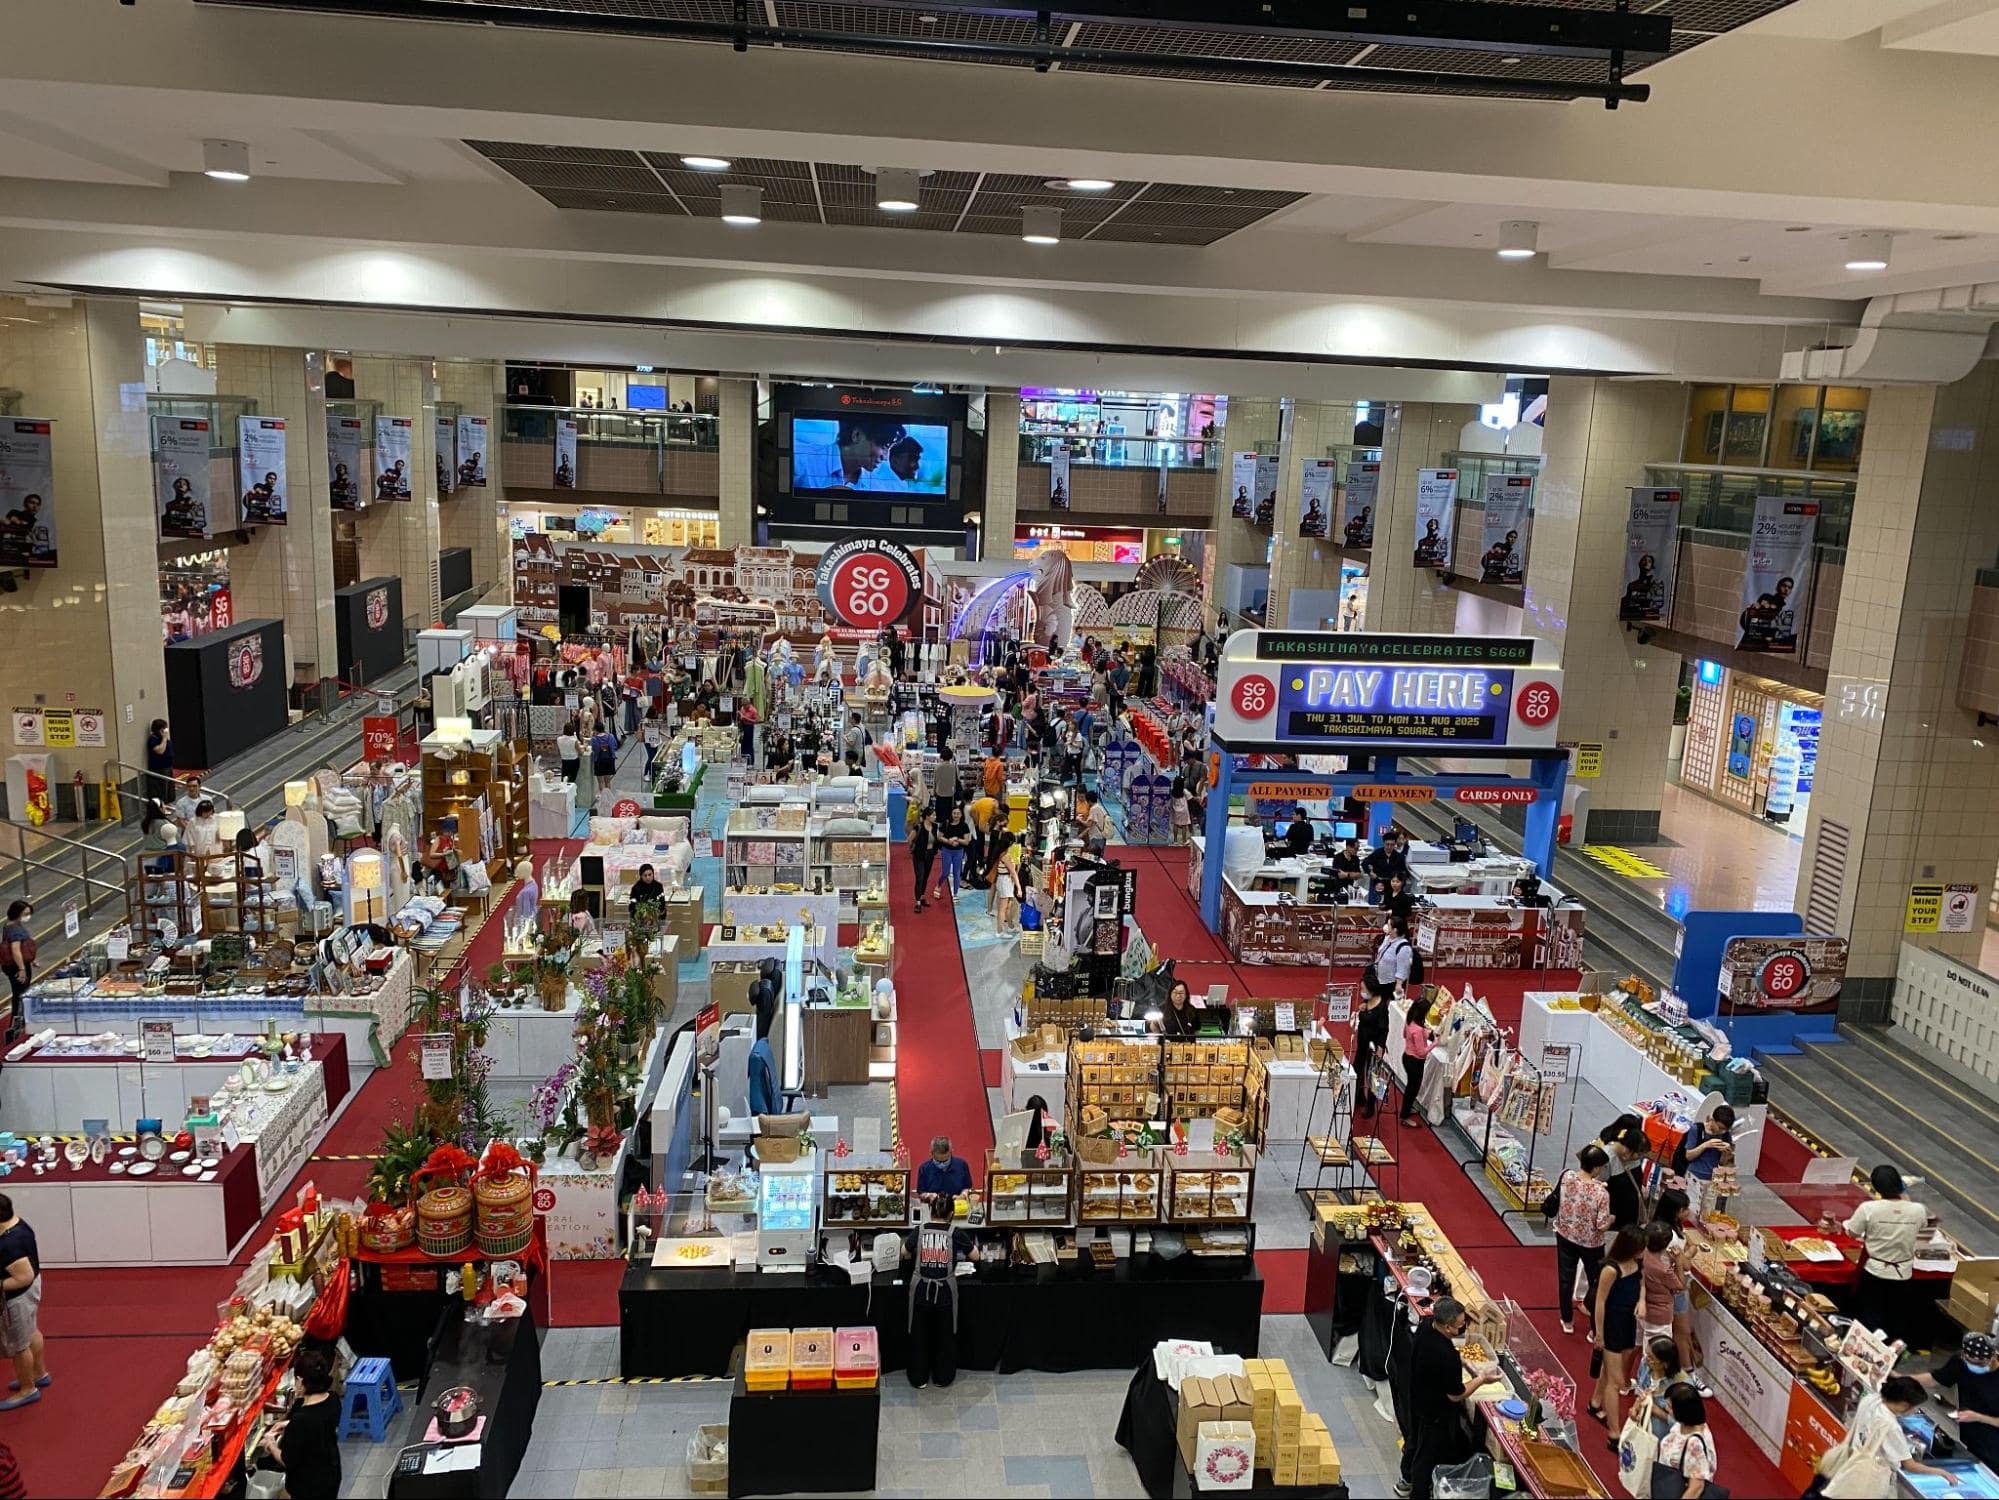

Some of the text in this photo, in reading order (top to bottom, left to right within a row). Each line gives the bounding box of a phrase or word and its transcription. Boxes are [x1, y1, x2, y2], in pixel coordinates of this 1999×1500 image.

[160, 435, 178, 446] 6%
[1420, 485, 1434, 494] 6%
[1489, 492, 1504, 502] 2%
[1633, 509, 1649, 520] 6%
[1756, 522, 1777, 535] 2%
[817, 539, 922, 590] Takashimaya Celebrates
[851, 566, 891, 591] SG
[216, 597, 227, 613] SG
[849, 590, 889, 616] 60
[1267, 641, 1526, 658] TAKASHIMAYA CELEBRATES SG60
[1243, 682, 1266, 697] SG
[1307, 669, 1487, 710] PAY HERE
[1528, 690, 1551, 704] SG
[1242, 697, 1265, 711] 60
[1525, 704, 1549, 719] 60
[1306, 713, 1480, 726] THU 31 JUL TO MON 11 AUG 2025
[1323, 724, 1393, 735] TAKASHIMAYA
[1397, 726, 1438, 736] SQUARE,
[366, 732, 395, 744] 70%
[1251, 786, 1331, 797] ALL PAYMENT
[1354, 788, 1434, 800] ALL PAYMENT
[1460, 790, 1534, 801] CARDS ONLY
[619, 802, 635, 812] SG
[1912, 907, 1937, 915] YOUR
[1773, 963, 1795, 977] SG
[1771, 977, 1793, 990] 60
[1946, 969, 1990, 999] DO NOT LEAN
[537, 1192, 551, 1200] SG
[537, 1200, 551, 1208] 60
